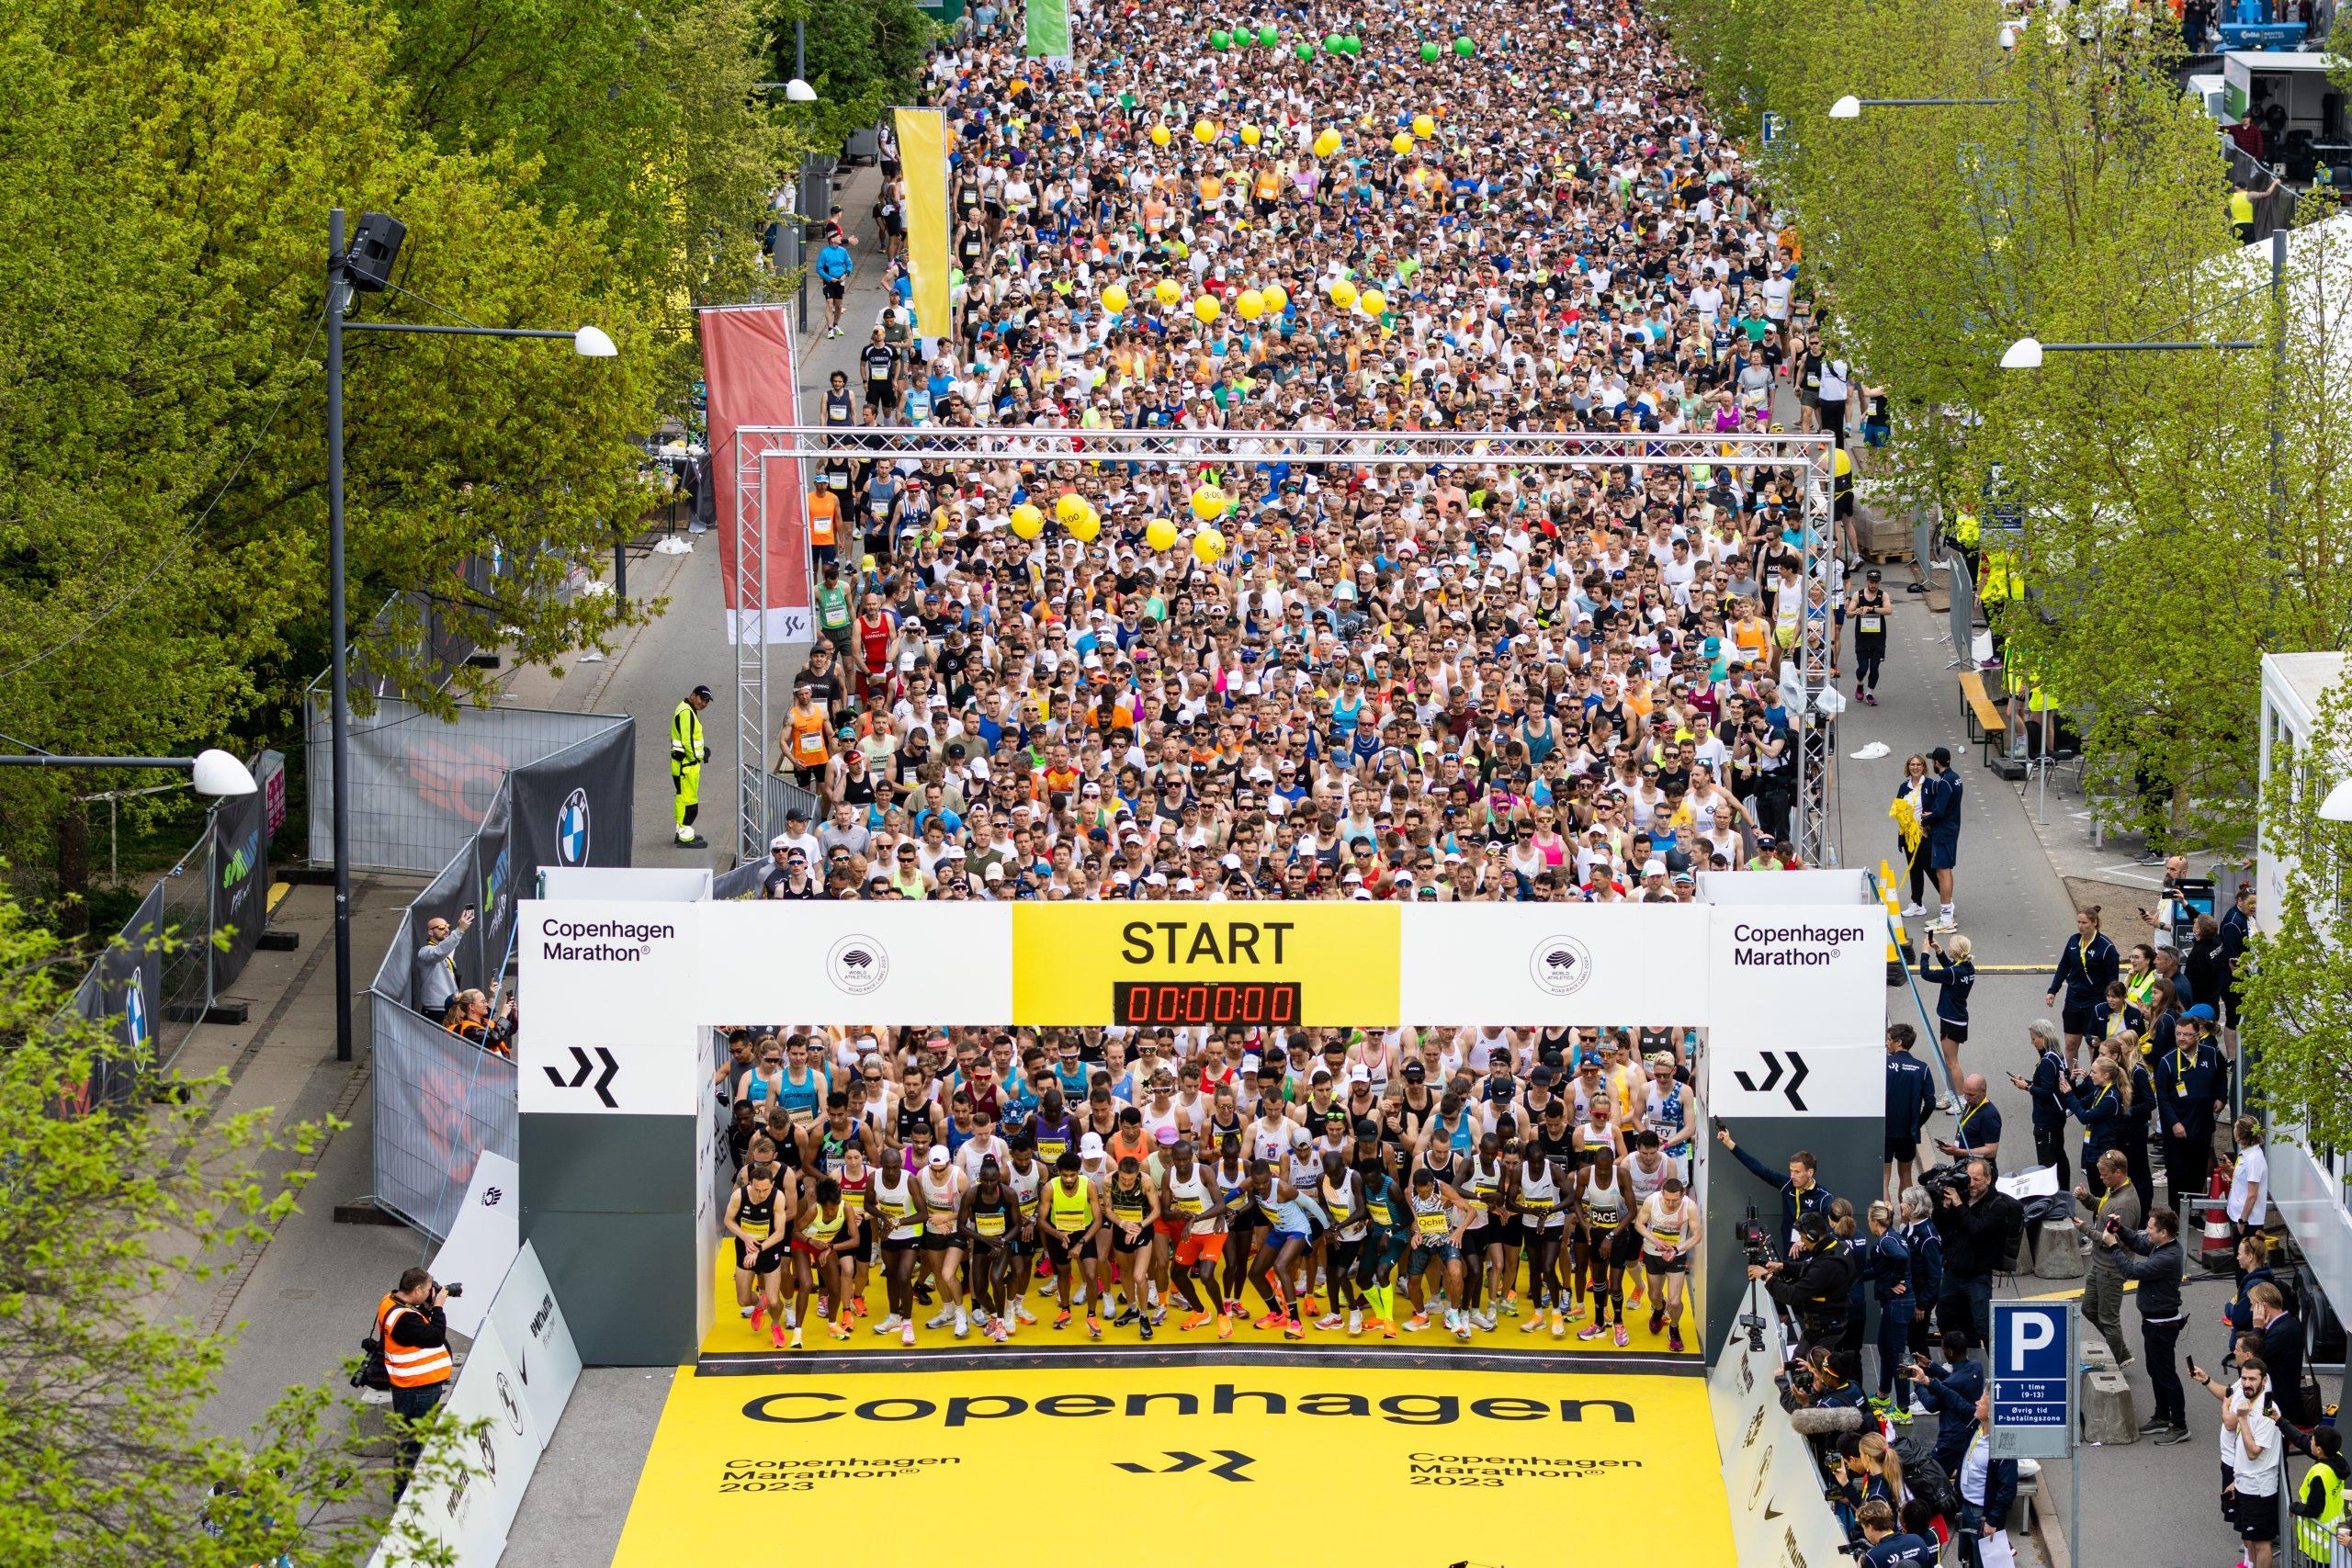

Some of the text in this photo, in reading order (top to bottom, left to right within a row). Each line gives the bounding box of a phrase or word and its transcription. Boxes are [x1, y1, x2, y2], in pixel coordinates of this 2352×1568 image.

[1204, 491, 1222, 500] 3:00
[1061, 513, 1080, 524] 3:00
[543, 919, 674, 942] Copenhagen
[1735, 924, 1864, 946] Copenhagen
[1122, 921, 1295, 964] START
[1128, 987, 1294, 1021] 00:00:00
[1066, 1100, 1082, 1111] ACE
[1655, 1125, 1671, 1136] Fry
[1039, 1145, 1065, 1155] Kiptoo
[1419, 1217, 1445, 1227] Ochir
[1592, 1212, 1617, 1223] PACE
[2011, 1312, 2055, 1371] P
[2021, 1391, 2044, 1399] (9-13)
[741, 1383, 1635, 1428] Copenhagen
[2011, 1406, 2033, 1416] Øvrig
[1998, 1415, 2061, 1423] P-betalingszone
[725, 1457, 961, 1470] Copenhagen
[1408, 1452, 1643, 1468] Copenhagen
[1409, 1475, 1505, 1487] 2023
[718, 1482, 814, 1493] 2023
